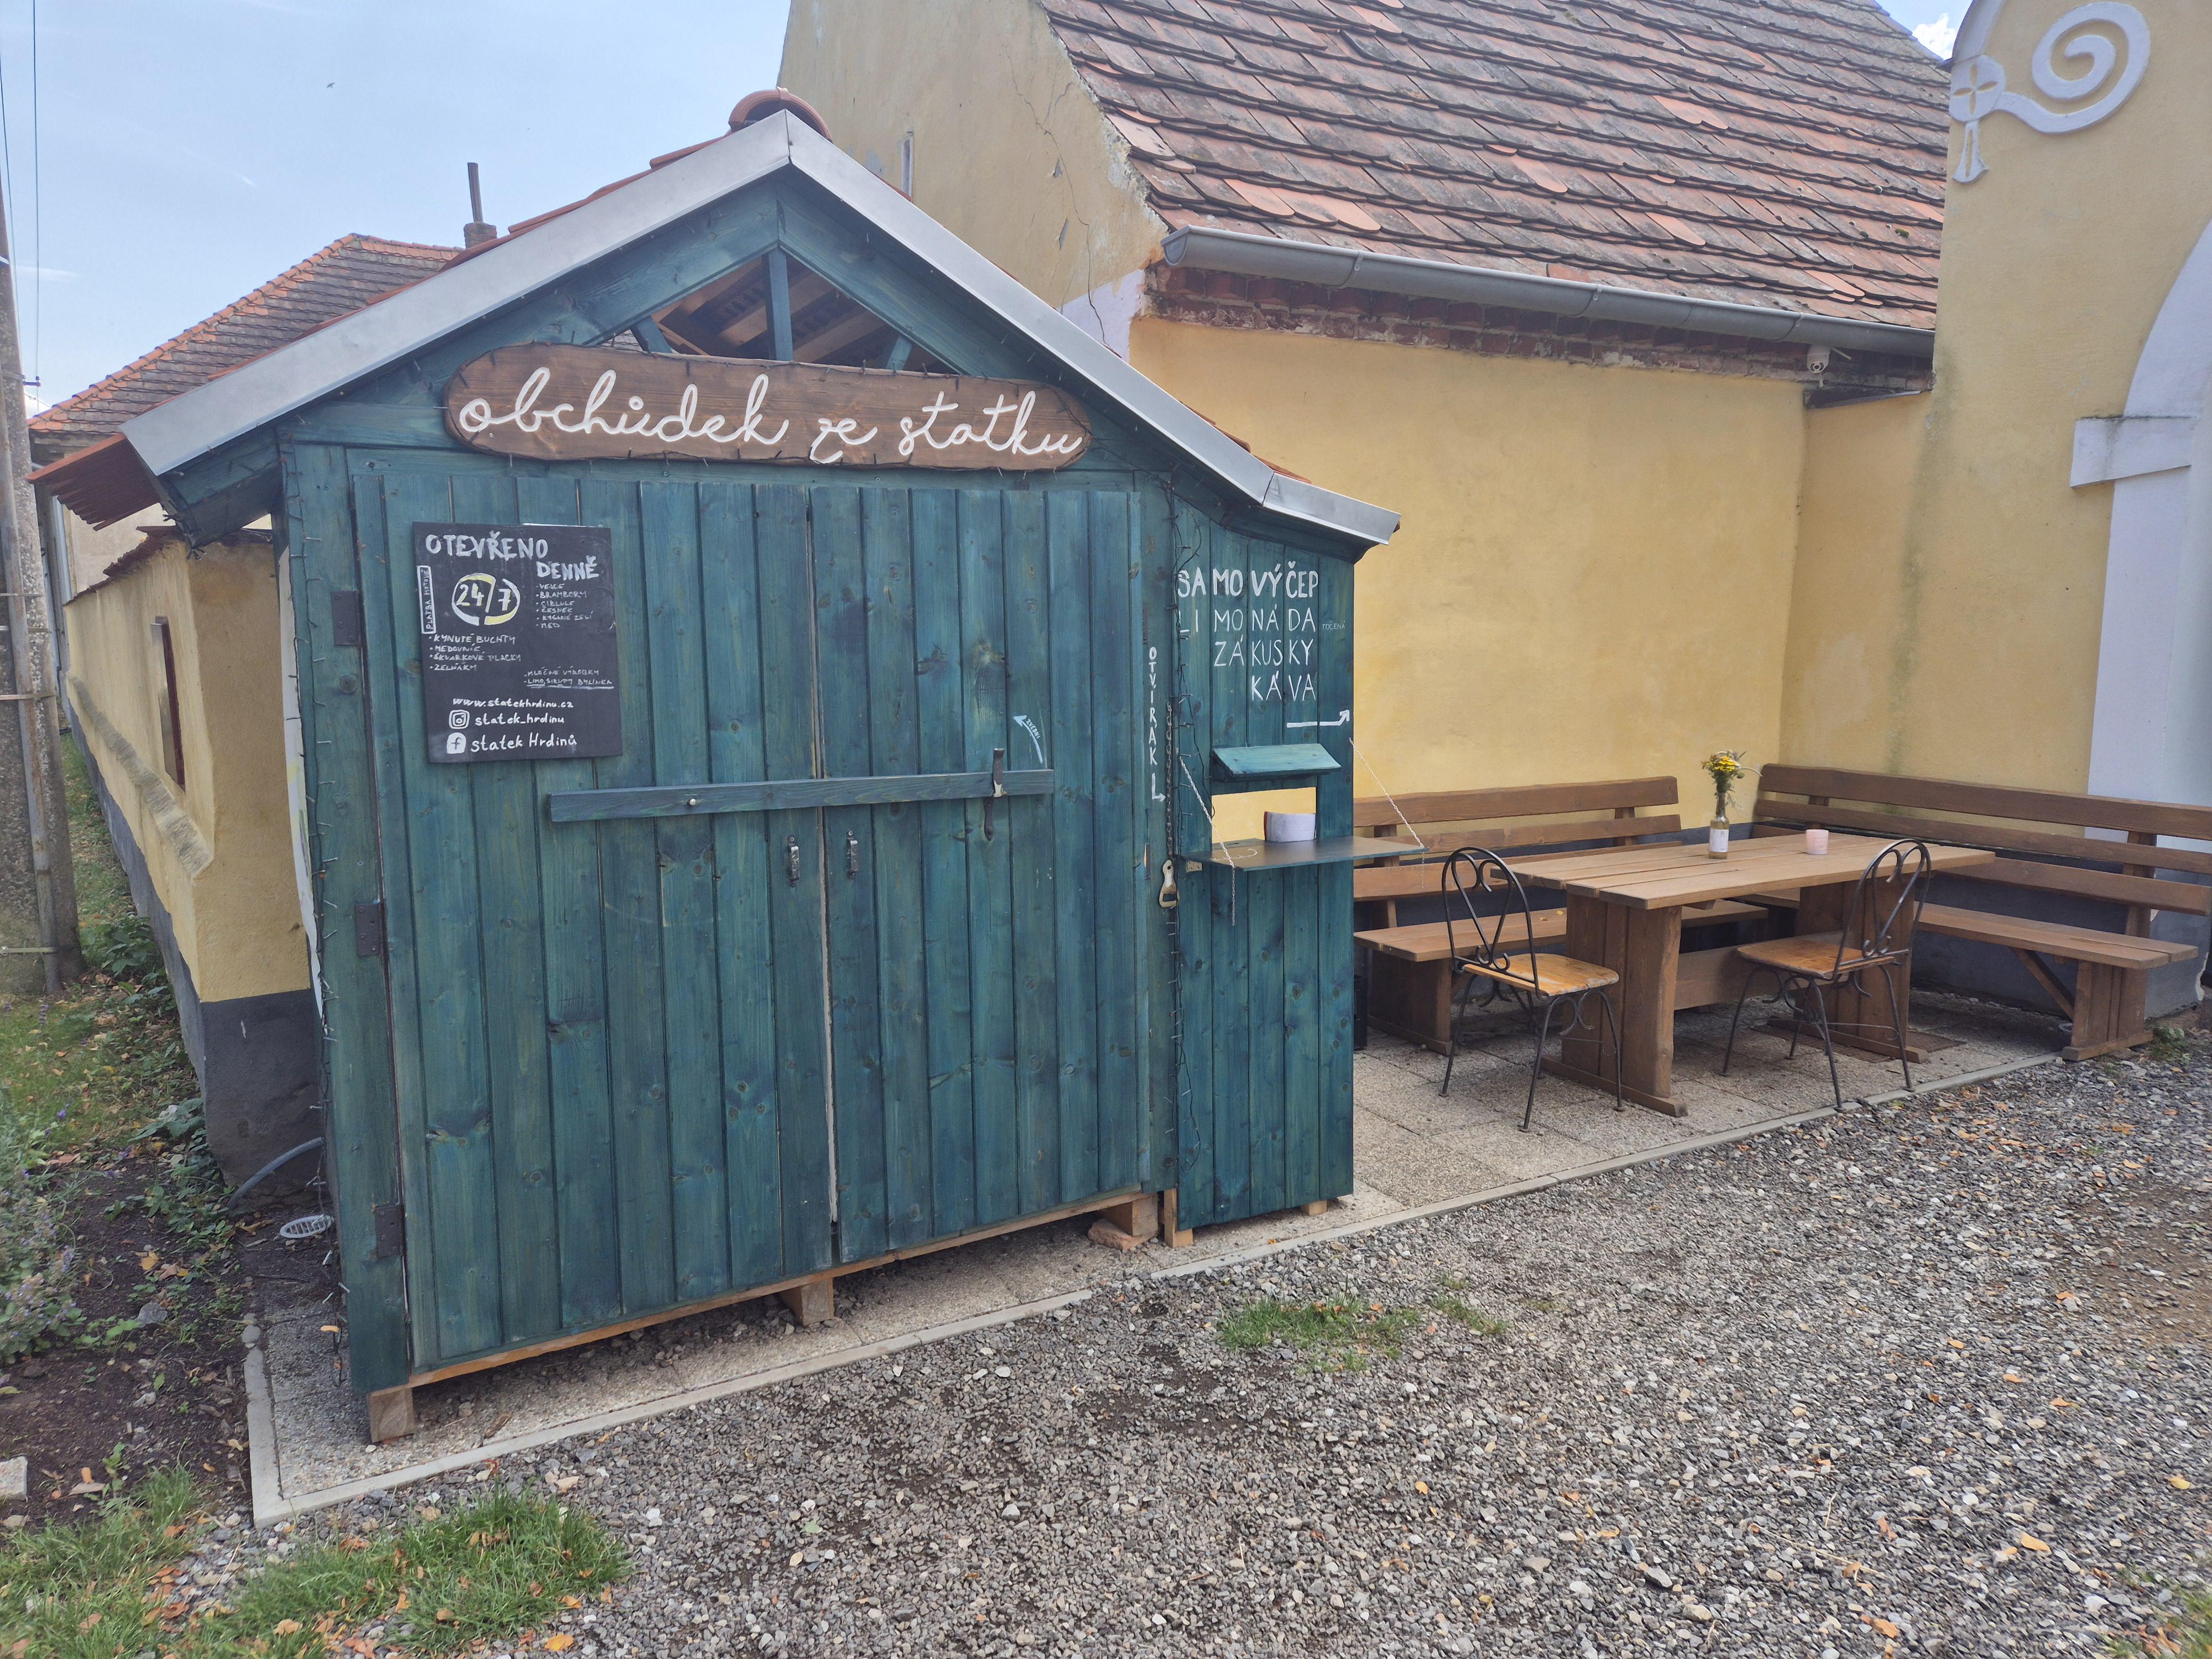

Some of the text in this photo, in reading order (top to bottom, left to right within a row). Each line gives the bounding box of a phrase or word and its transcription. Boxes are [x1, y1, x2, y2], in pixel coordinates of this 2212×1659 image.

[460, 367, 1083, 464] obchůdek ze statku
[425, 530, 549, 561] OTEVŘENO
[536, 555, 599, 581] DENNĚ
[424, 599, 434, 629] PLATBA
[434, 633, 516, 645] KYNUTÉ BUCHTY
[435, 643, 481, 653] MEDOVNÍK
[563, 665, 599, 675] VÝROBKY
[1251, 671, 1316, 702] KÁVA
[452, 697, 574, 708] www.statekhrdinu.cz
[474, 712, 565, 726] statek_hrdinu
[1026, 718, 1041, 739] ZVEDNI
[470, 734, 524, 753] statek
[529, 731, 577, 748] Hrdinů
